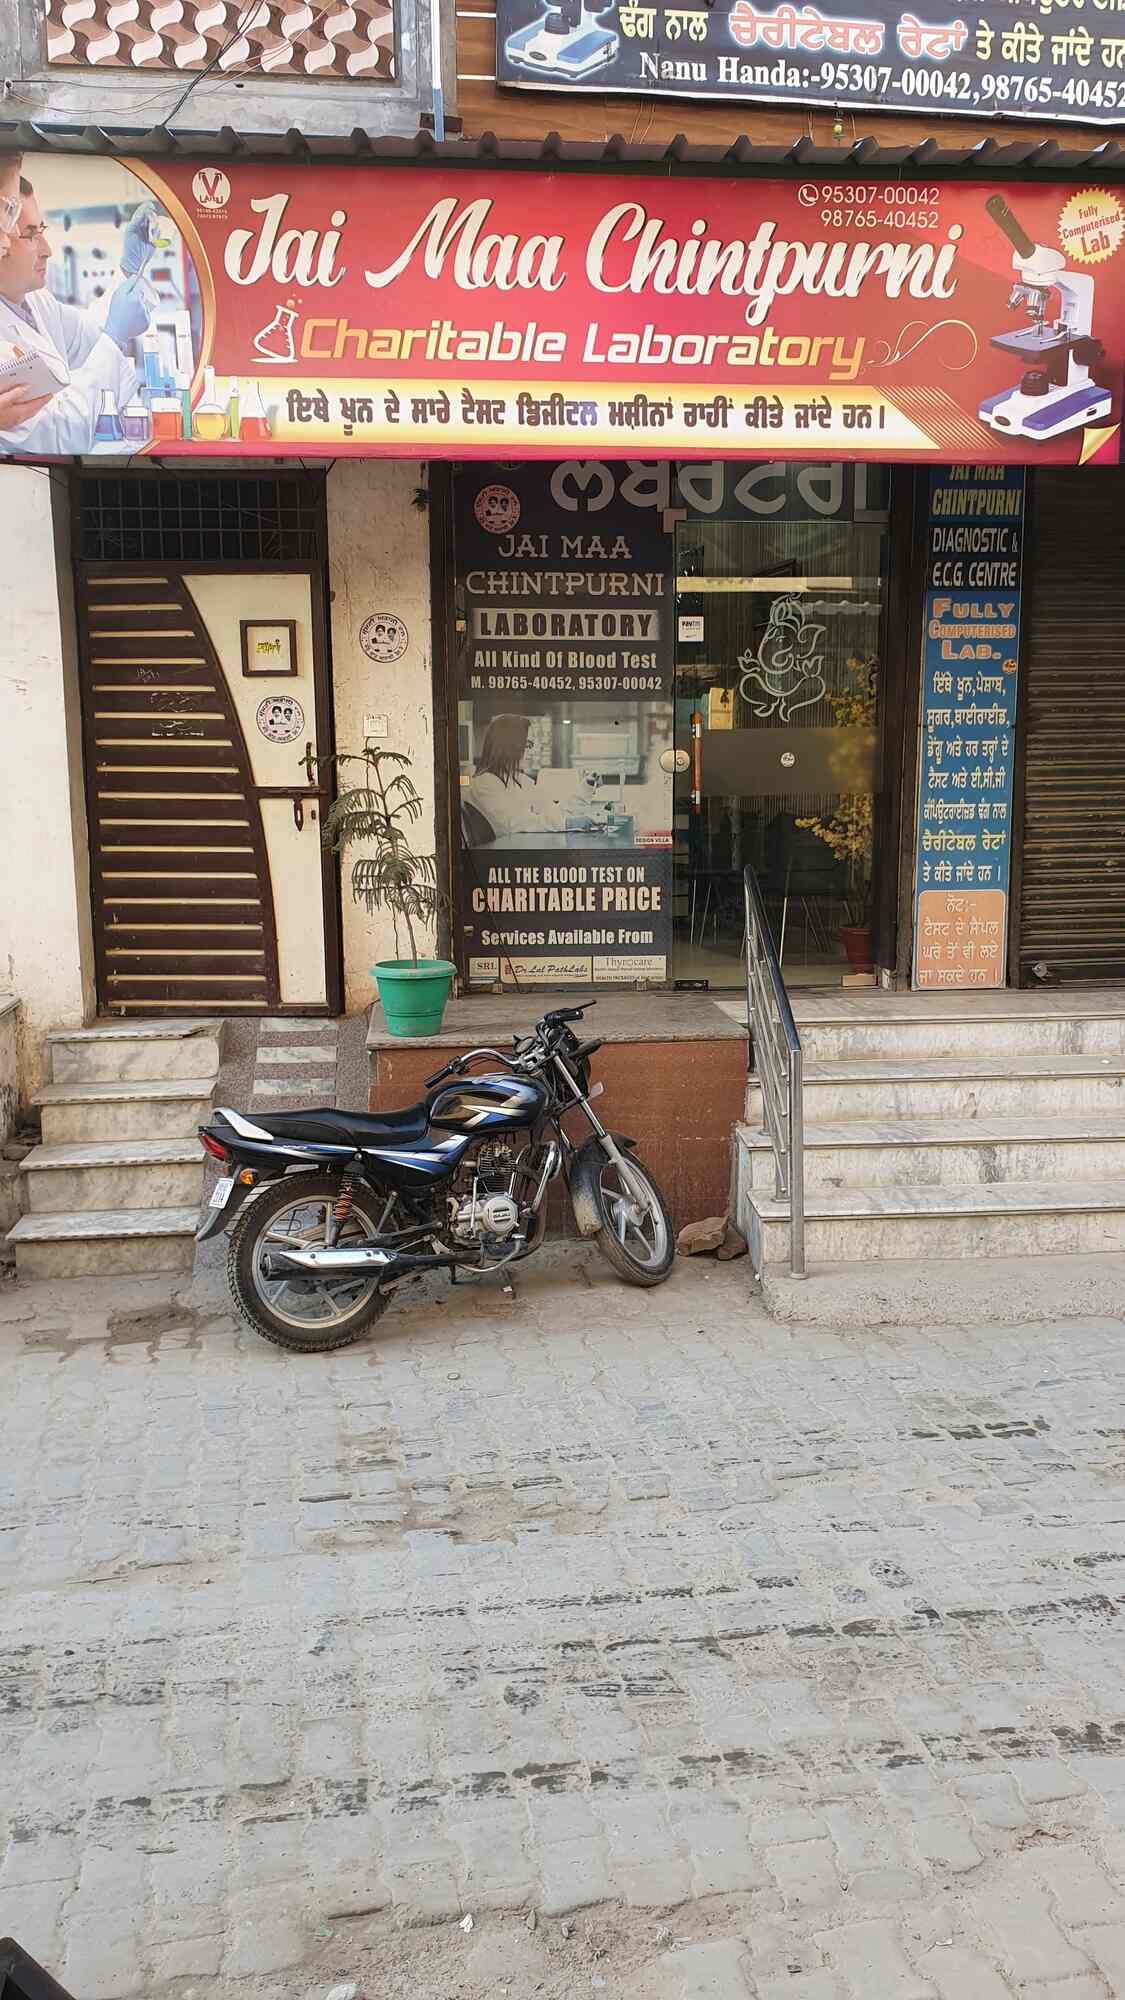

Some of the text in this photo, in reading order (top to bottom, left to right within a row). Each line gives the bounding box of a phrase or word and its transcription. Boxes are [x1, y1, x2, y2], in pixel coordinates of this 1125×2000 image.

[664, 8, 709, 42] ਨਾਲ
[896, 13, 968, 59] ਰੇਟਾਂ
[975, 19, 995, 61] ਤੇ
[1001, 21, 1045, 64] ਕੀਤੇ
[1050, 25, 1095, 68] ਜਾਂਦੇ
[638, 51, 707, 81] Nanu
[821, 186, 940, 207] 95307-00042
[821, 209, 940, 230] 98765-40452
[1062, 210, 1121, 239] Computerised
[1078, 205, 1098, 219] Fully
[1081, 230, 1111, 256] Lab
[224, 193, 964, 327] Jai Maa Chintpurni
[301, 318, 865, 381] Charitable Laboratory
[339, 397, 374, 437] ਖੂਨ
[384, 388, 400, 424] ਦੇ
[411, 389, 451, 425] ਸਾਰੇ
[461, 388, 506, 425] ਟੈਸਟ
[516, 391, 599, 427] ਡਿਜੀਟਲ
[683, 394, 734, 428] ਰਾਹੀਂ
[744, 395, 784, 429] ਕੀਤੇ
[794, 395, 832, 429] ਜਾਂਦੇ
[932, 488, 1022, 515] CHINTPURNI
[498, 534, 632, 559] JAI MAA
[932, 527, 1018, 553] DIAGNOSTIC &
[466, 571, 665, 597] CHINTPURNI
[932, 561, 1017, 588] E.C.G. CENTRE
[479, 613, 652, 638] LABORATORY
[474, 650, 657, 669] All Kind Of Blood Test
[471, 675, 662, 691] M. 98765-40452, 95307-00042
[946, 734, 963, 758] ਅਤੇ
[965, 740, 979, 757] ਹਰ
[952, 766, 968, 789] ਅਤੇ
[488, 866, 645, 884] ALL THE BLOOD TEST ON
[472, 887, 662, 913] CHARITABLE PRICE
[481, 929, 654, 946] Services Available From
[476, 962, 497, 971] SRL
